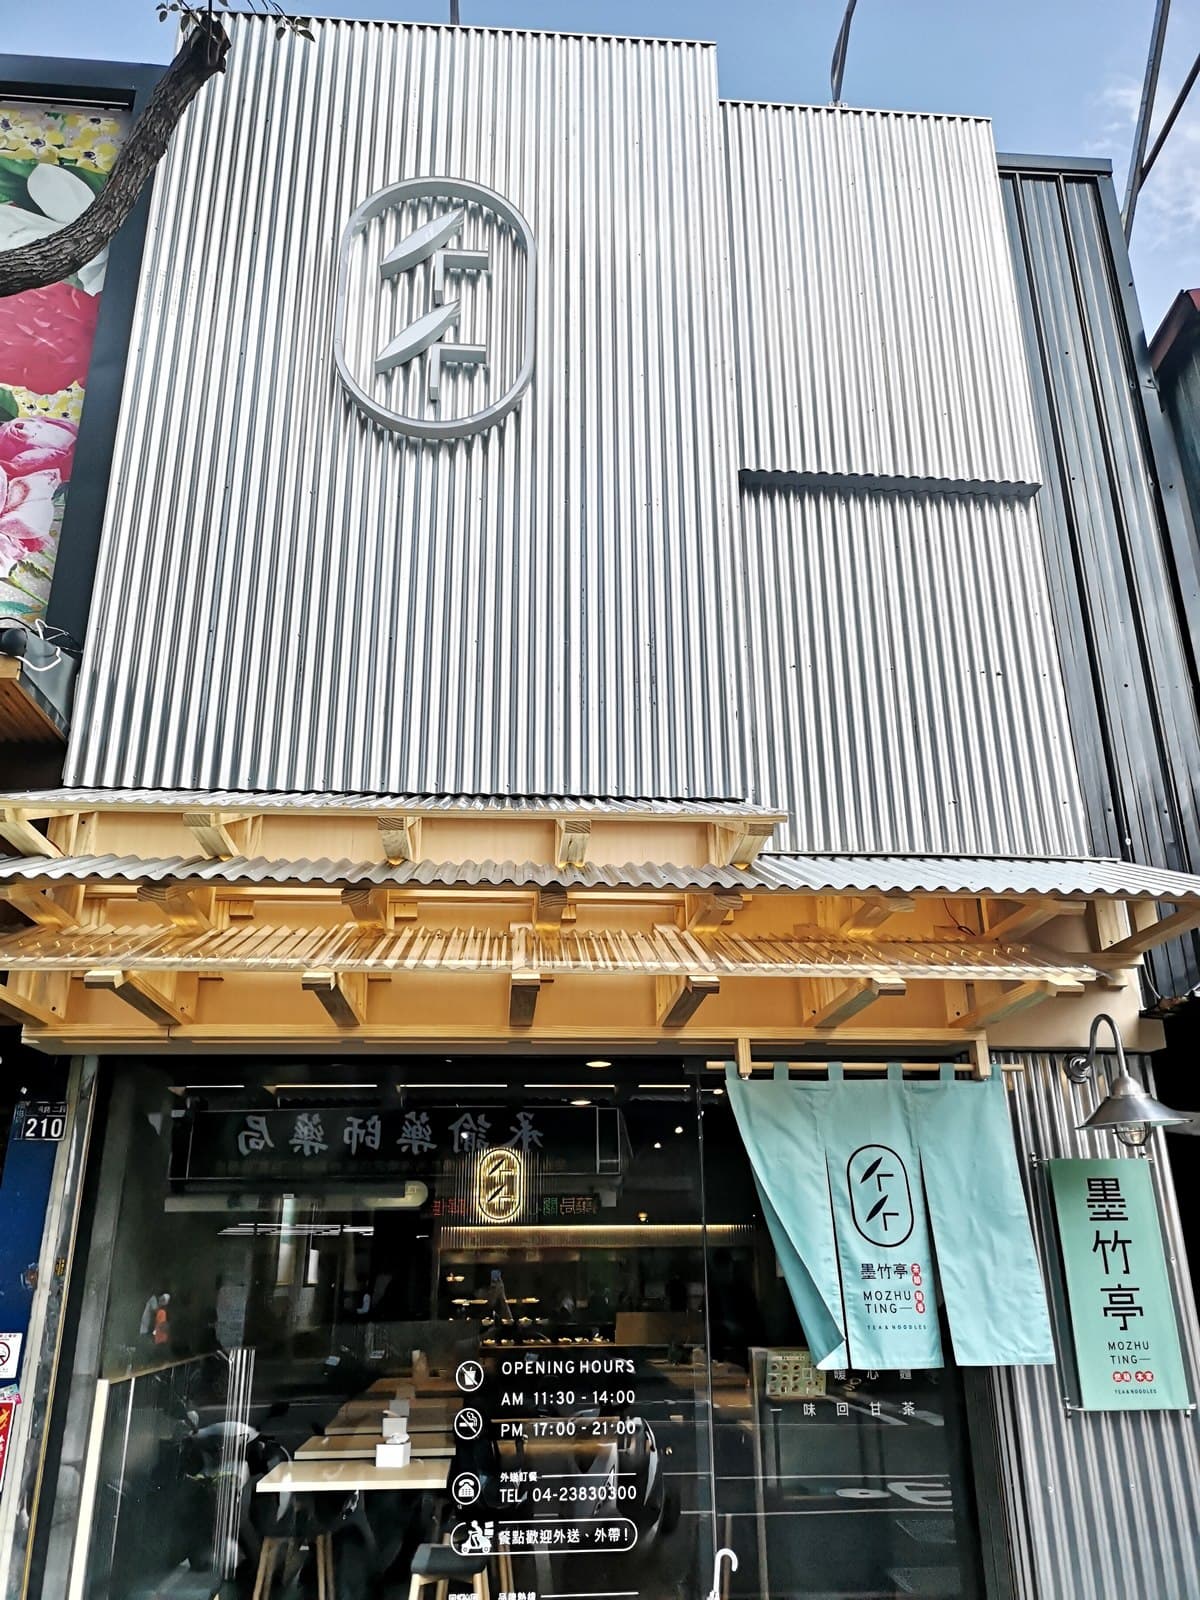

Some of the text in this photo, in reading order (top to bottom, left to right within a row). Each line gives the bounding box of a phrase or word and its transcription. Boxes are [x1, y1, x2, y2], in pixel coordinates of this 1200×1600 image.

[25, 1118, 63, 1138] 210
[1086, 1178, 1144, 1331] 墨竹亭
[861, 1263, 908, 1280] 墨竹亭
[863, 1290, 912, 1301] MOZHU
[865, 1303, 897, 1314] TING
[1107, 1341, 1150, 1351] MOZHU
[501, 1359, 636, 1375] OPENING HOURS
[1110, 1355, 1138, 1364] TING
[501, 1392, 524, 1406] AM
[533, 1390, 575, 1405] 11:30
[592, 1389, 636, 1404] 14:00
[769, 1401, 915, 1417] 一味回甘茶
[501, 1423, 523, 1437] PM
[532, 1422, 576, 1436] 17:00
[592, 1421, 636, 1435] 21:00
[500, 1485, 637, 1503] TEL 04-23830300
